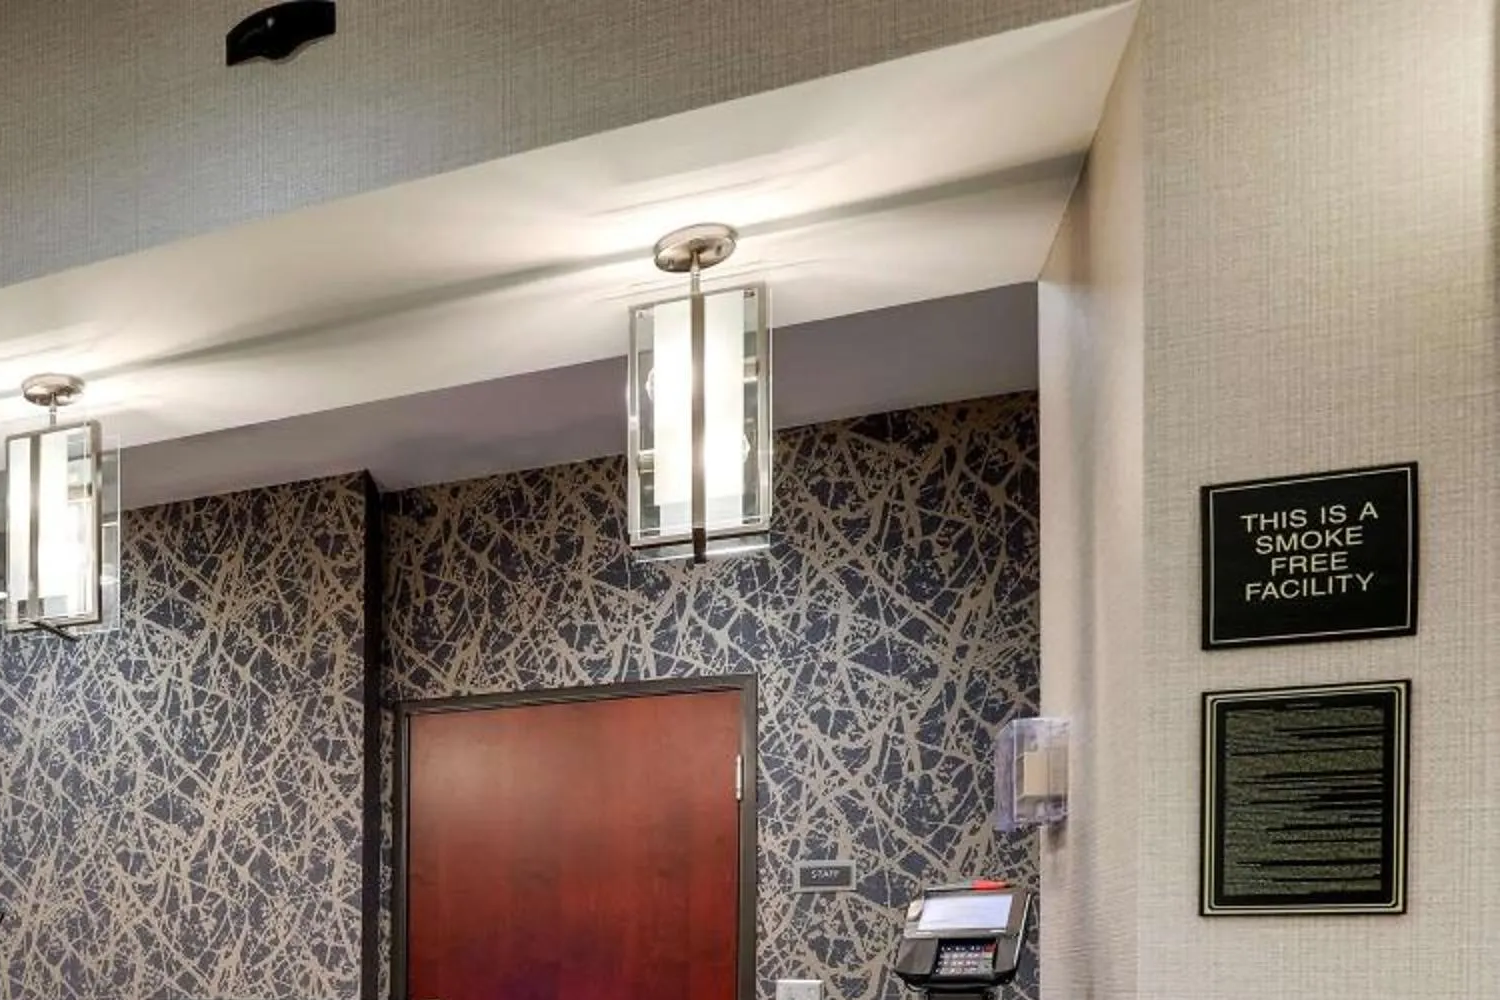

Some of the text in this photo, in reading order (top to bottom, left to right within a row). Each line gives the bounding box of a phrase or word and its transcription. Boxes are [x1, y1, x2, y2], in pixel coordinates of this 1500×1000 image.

[1240, 501, 1379, 533] THIS IS A
[1255, 525, 1363, 554] SMOKE
[1271, 551, 1349, 576] FREE
[1245, 571, 1375, 601] FACILITY
